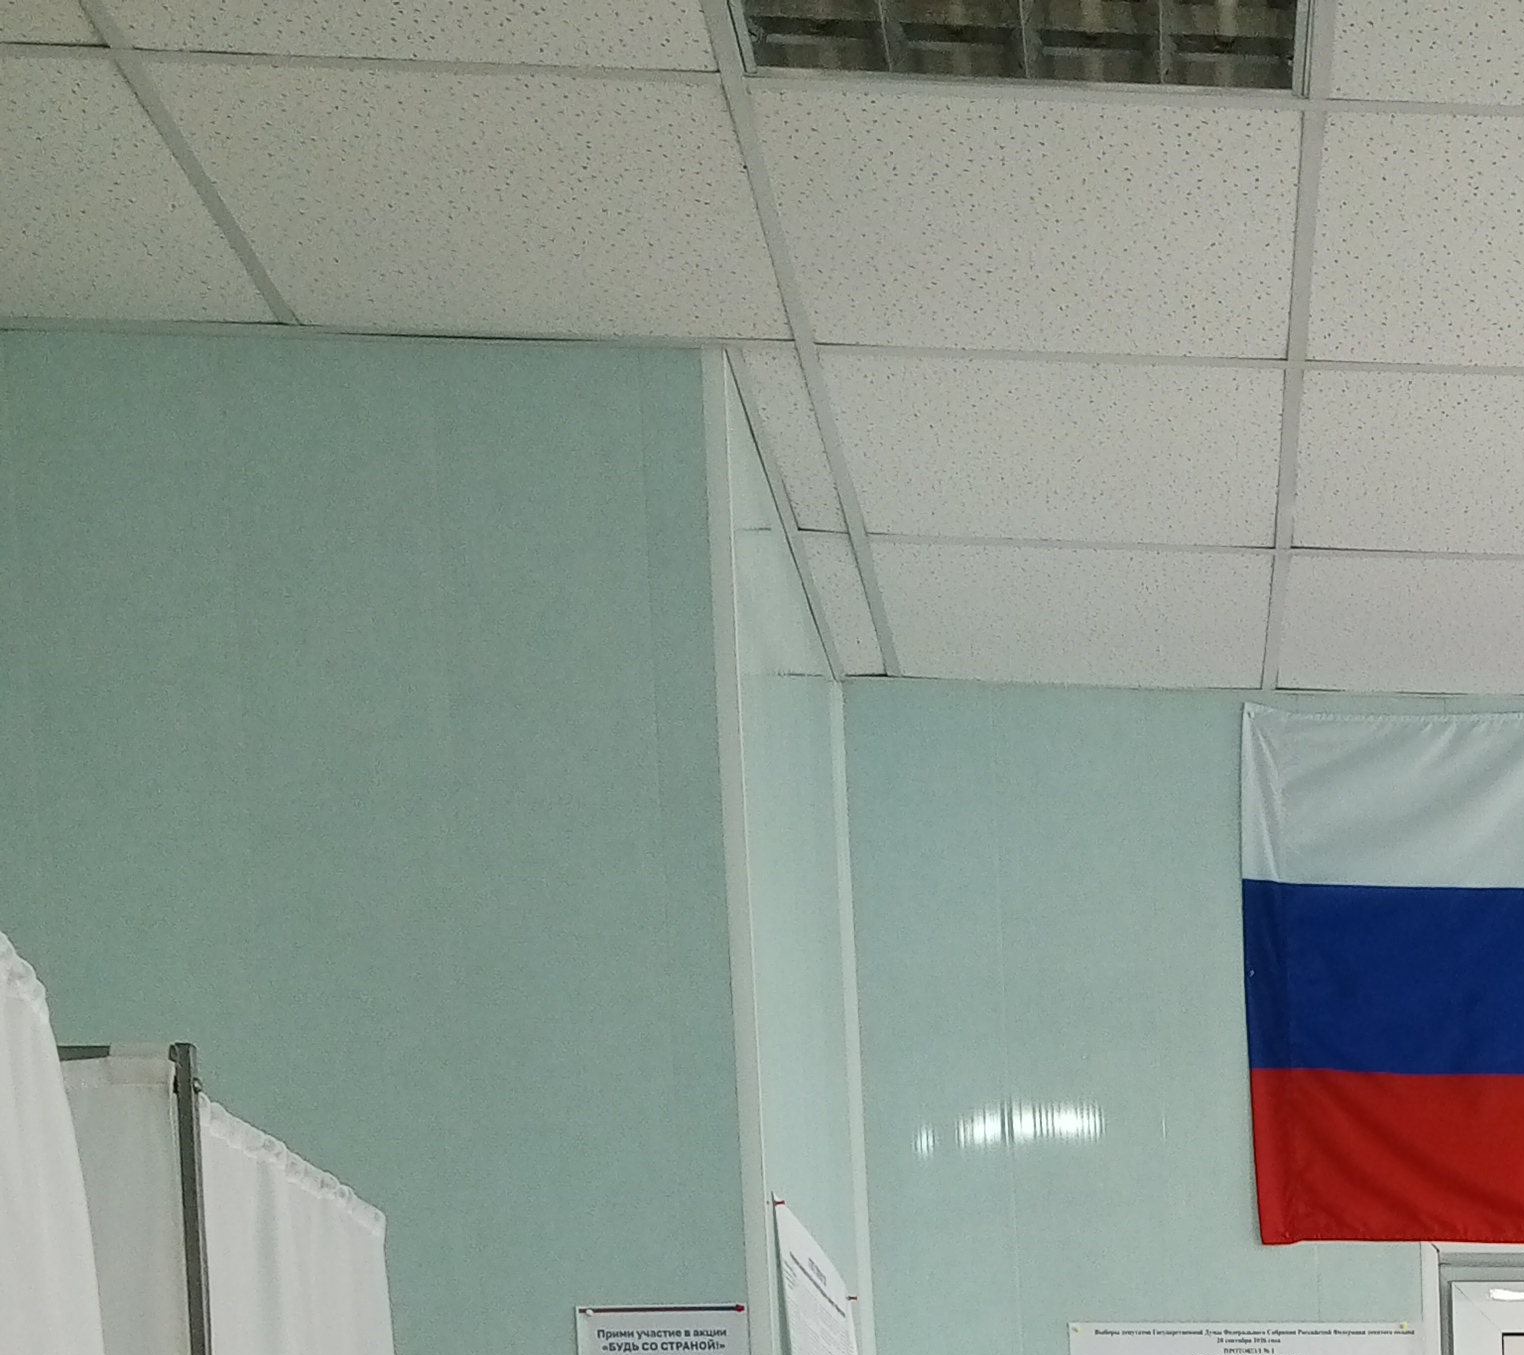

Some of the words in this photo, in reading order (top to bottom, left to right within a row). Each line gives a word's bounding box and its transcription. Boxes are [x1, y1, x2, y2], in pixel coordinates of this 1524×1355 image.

[597, 1330, 634, 1340] Прими
[636, 1330, 682, 1340] участие
[694, 1330, 726, 1338] акции
[602, 1342, 639, 1352] «БУДЬ
[642, 1342, 658, 1351] СО
[660, 1340, 726, 1350] СТРАНОЙ!»
